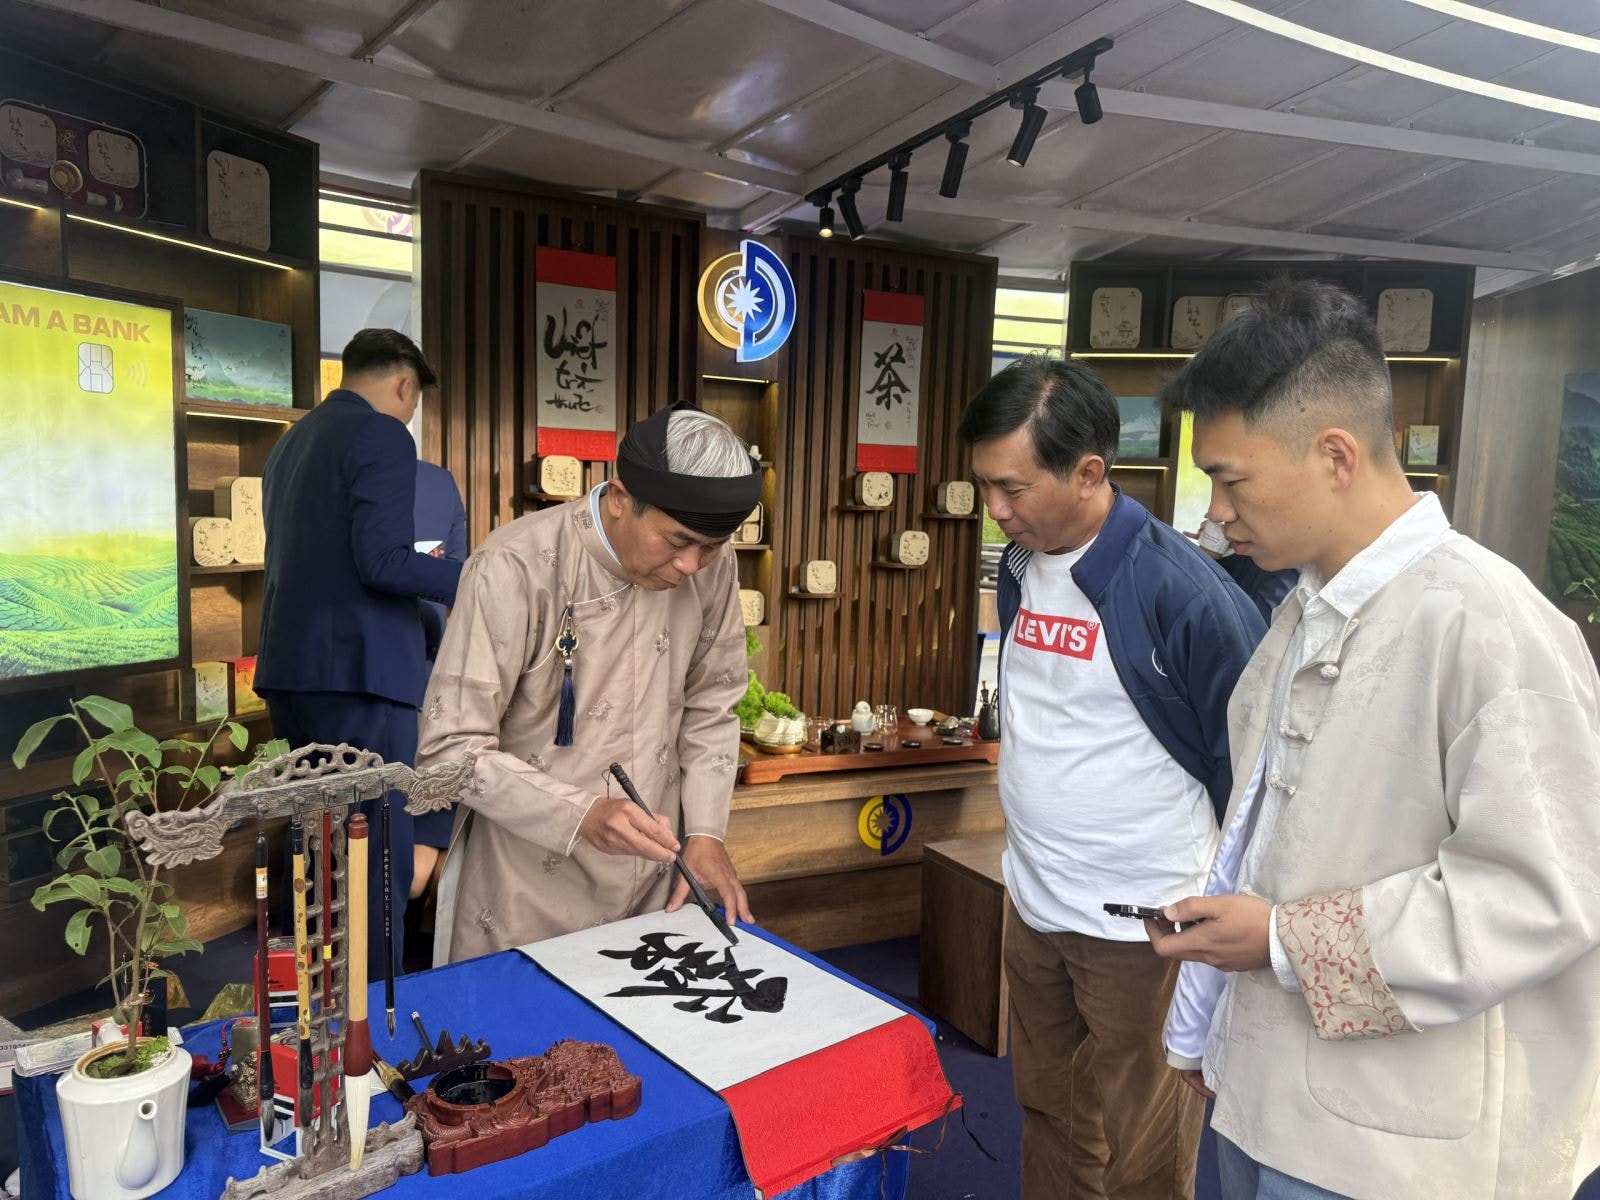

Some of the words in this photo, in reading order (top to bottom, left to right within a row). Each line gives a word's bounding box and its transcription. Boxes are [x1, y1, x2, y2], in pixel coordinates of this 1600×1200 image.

[46, 310, 68, 332] A
[73, 313, 152, 343] BANK
[865, 342, 912, 411] 茶
[1016, 614, 1089, 652] LEVI'S
